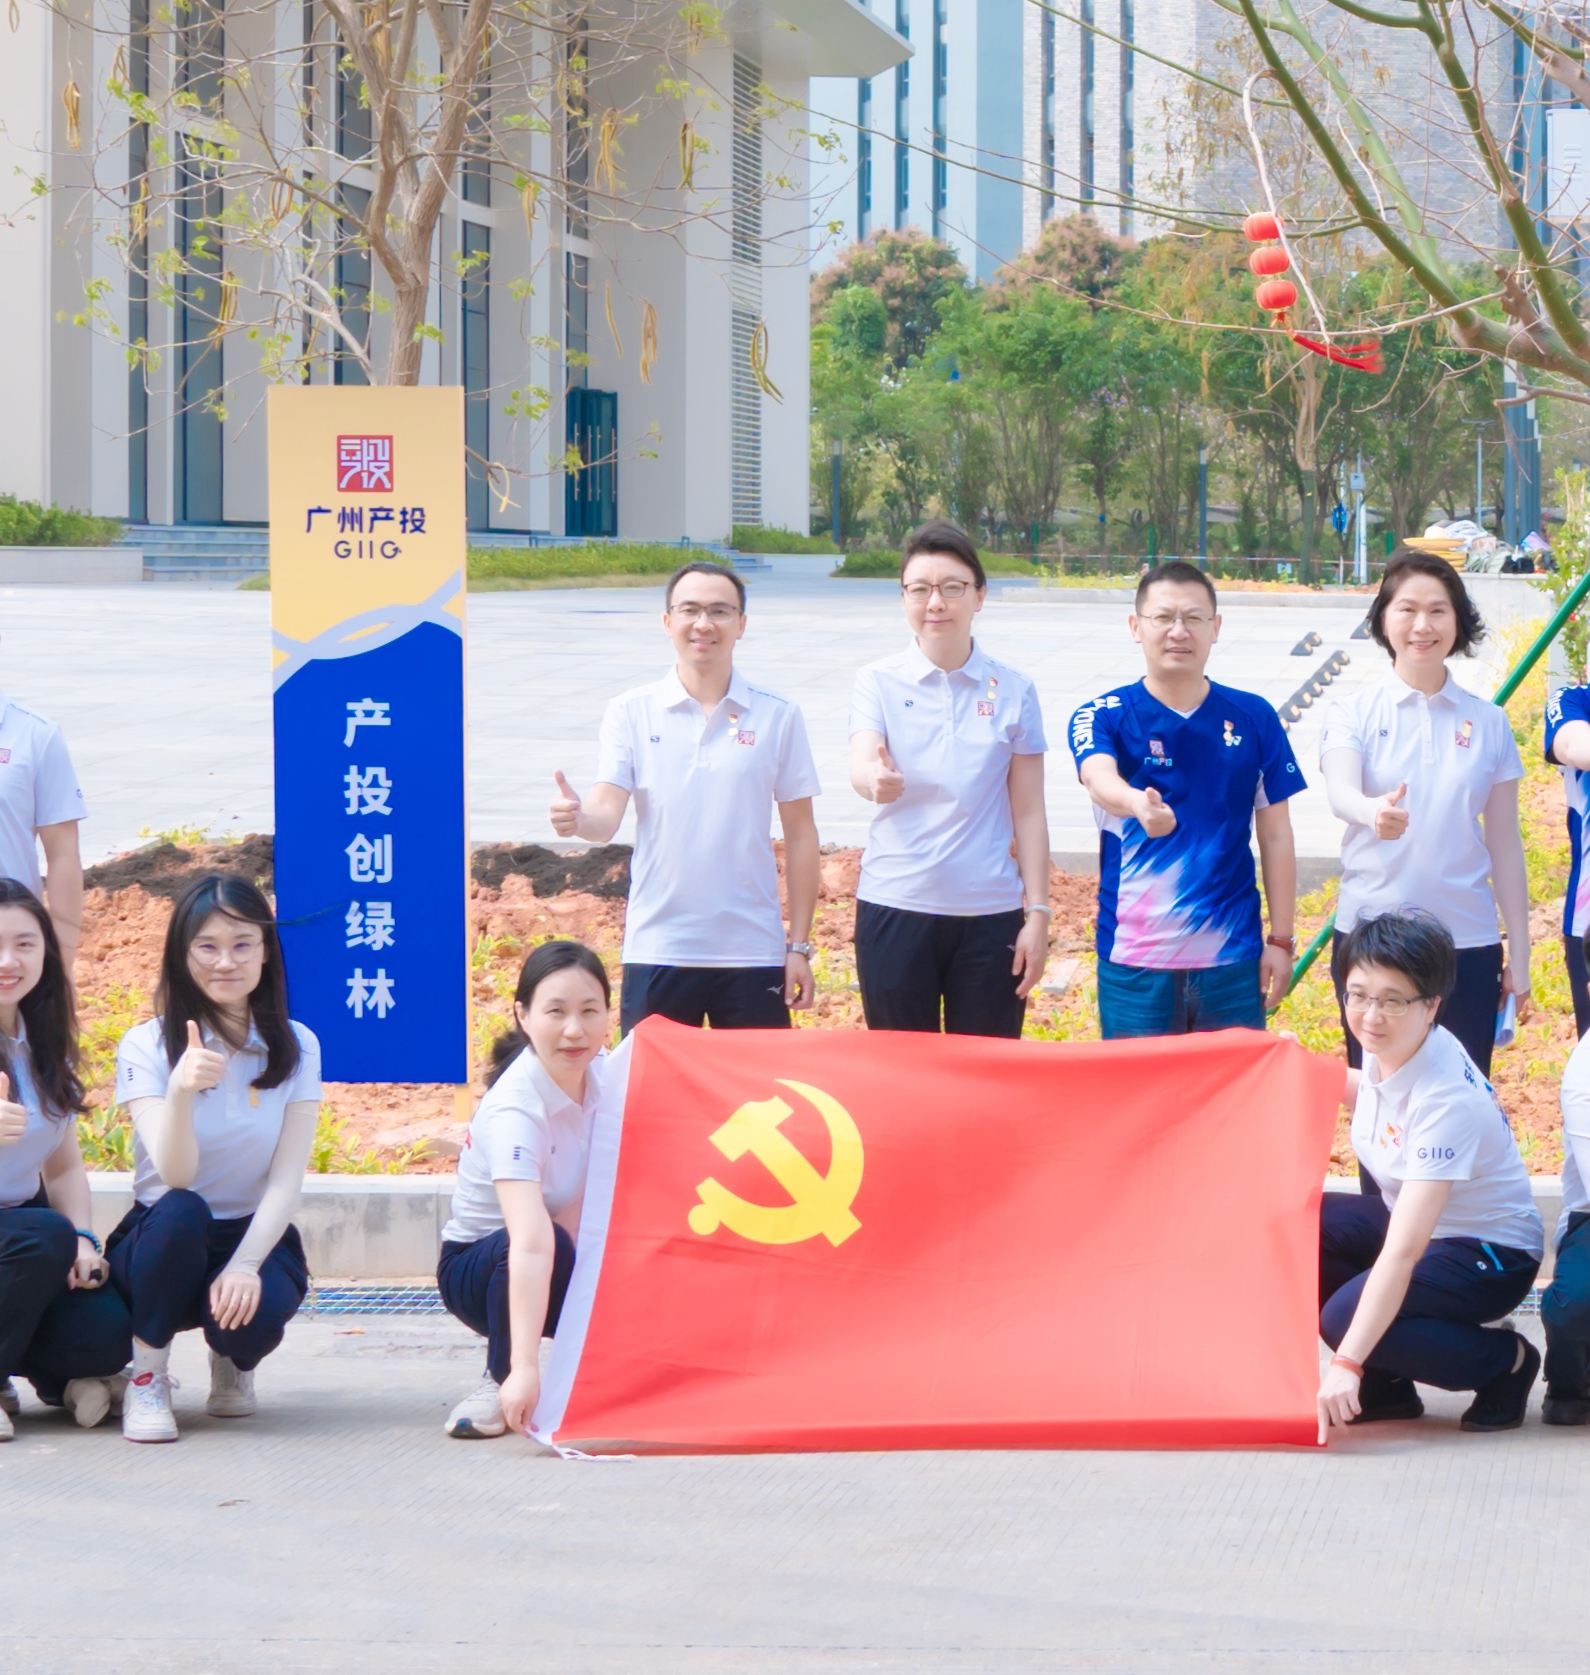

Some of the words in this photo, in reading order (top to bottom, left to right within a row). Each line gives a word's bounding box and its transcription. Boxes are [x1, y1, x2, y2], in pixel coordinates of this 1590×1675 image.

[306, 505, 426, 534] 广州产投
[334, 540, 402, 559] GIIG
[343, 697, 396, 1019] 产投创绿林
[1417, 1147, 1456, 1160] GIIG
